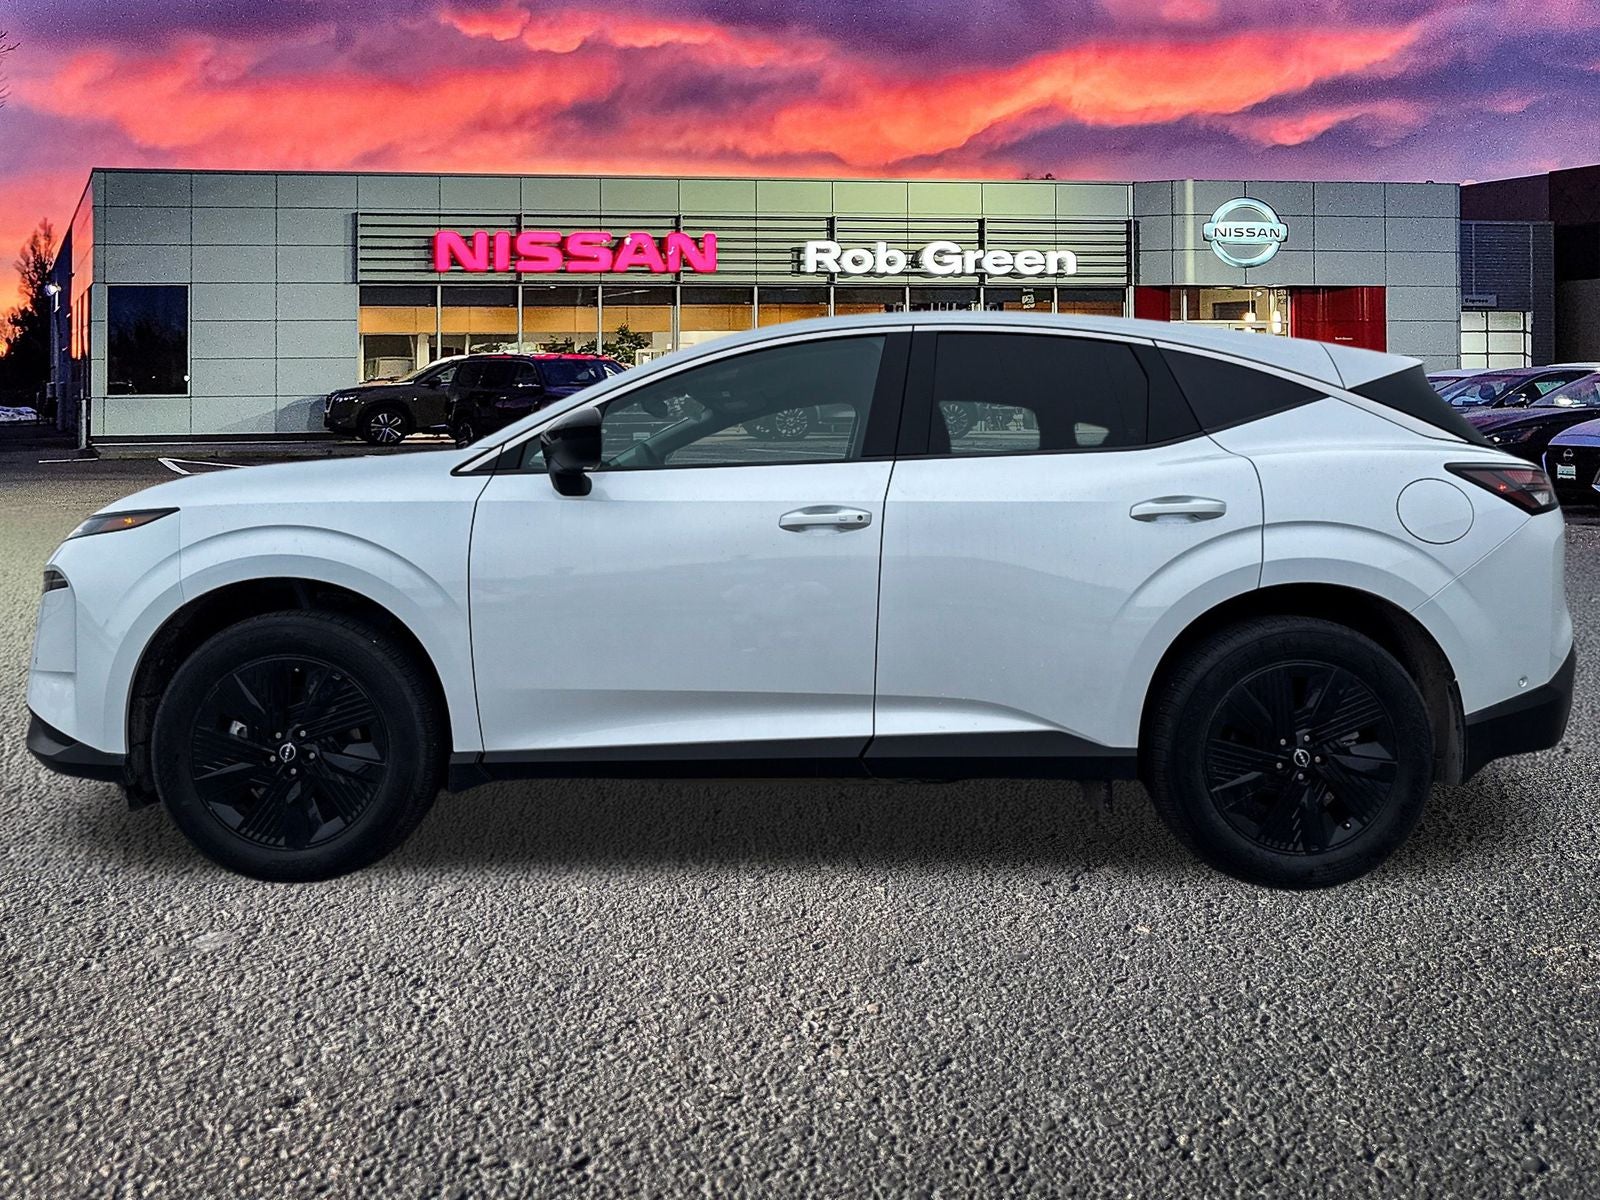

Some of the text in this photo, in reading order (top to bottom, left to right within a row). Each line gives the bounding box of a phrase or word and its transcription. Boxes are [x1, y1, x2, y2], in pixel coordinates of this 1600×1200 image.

[1214, 227, 1281, 238] NISSAN
[433, 230, 718, 273] NISSAN
[804, 240, 1078, 276] Rob Green
